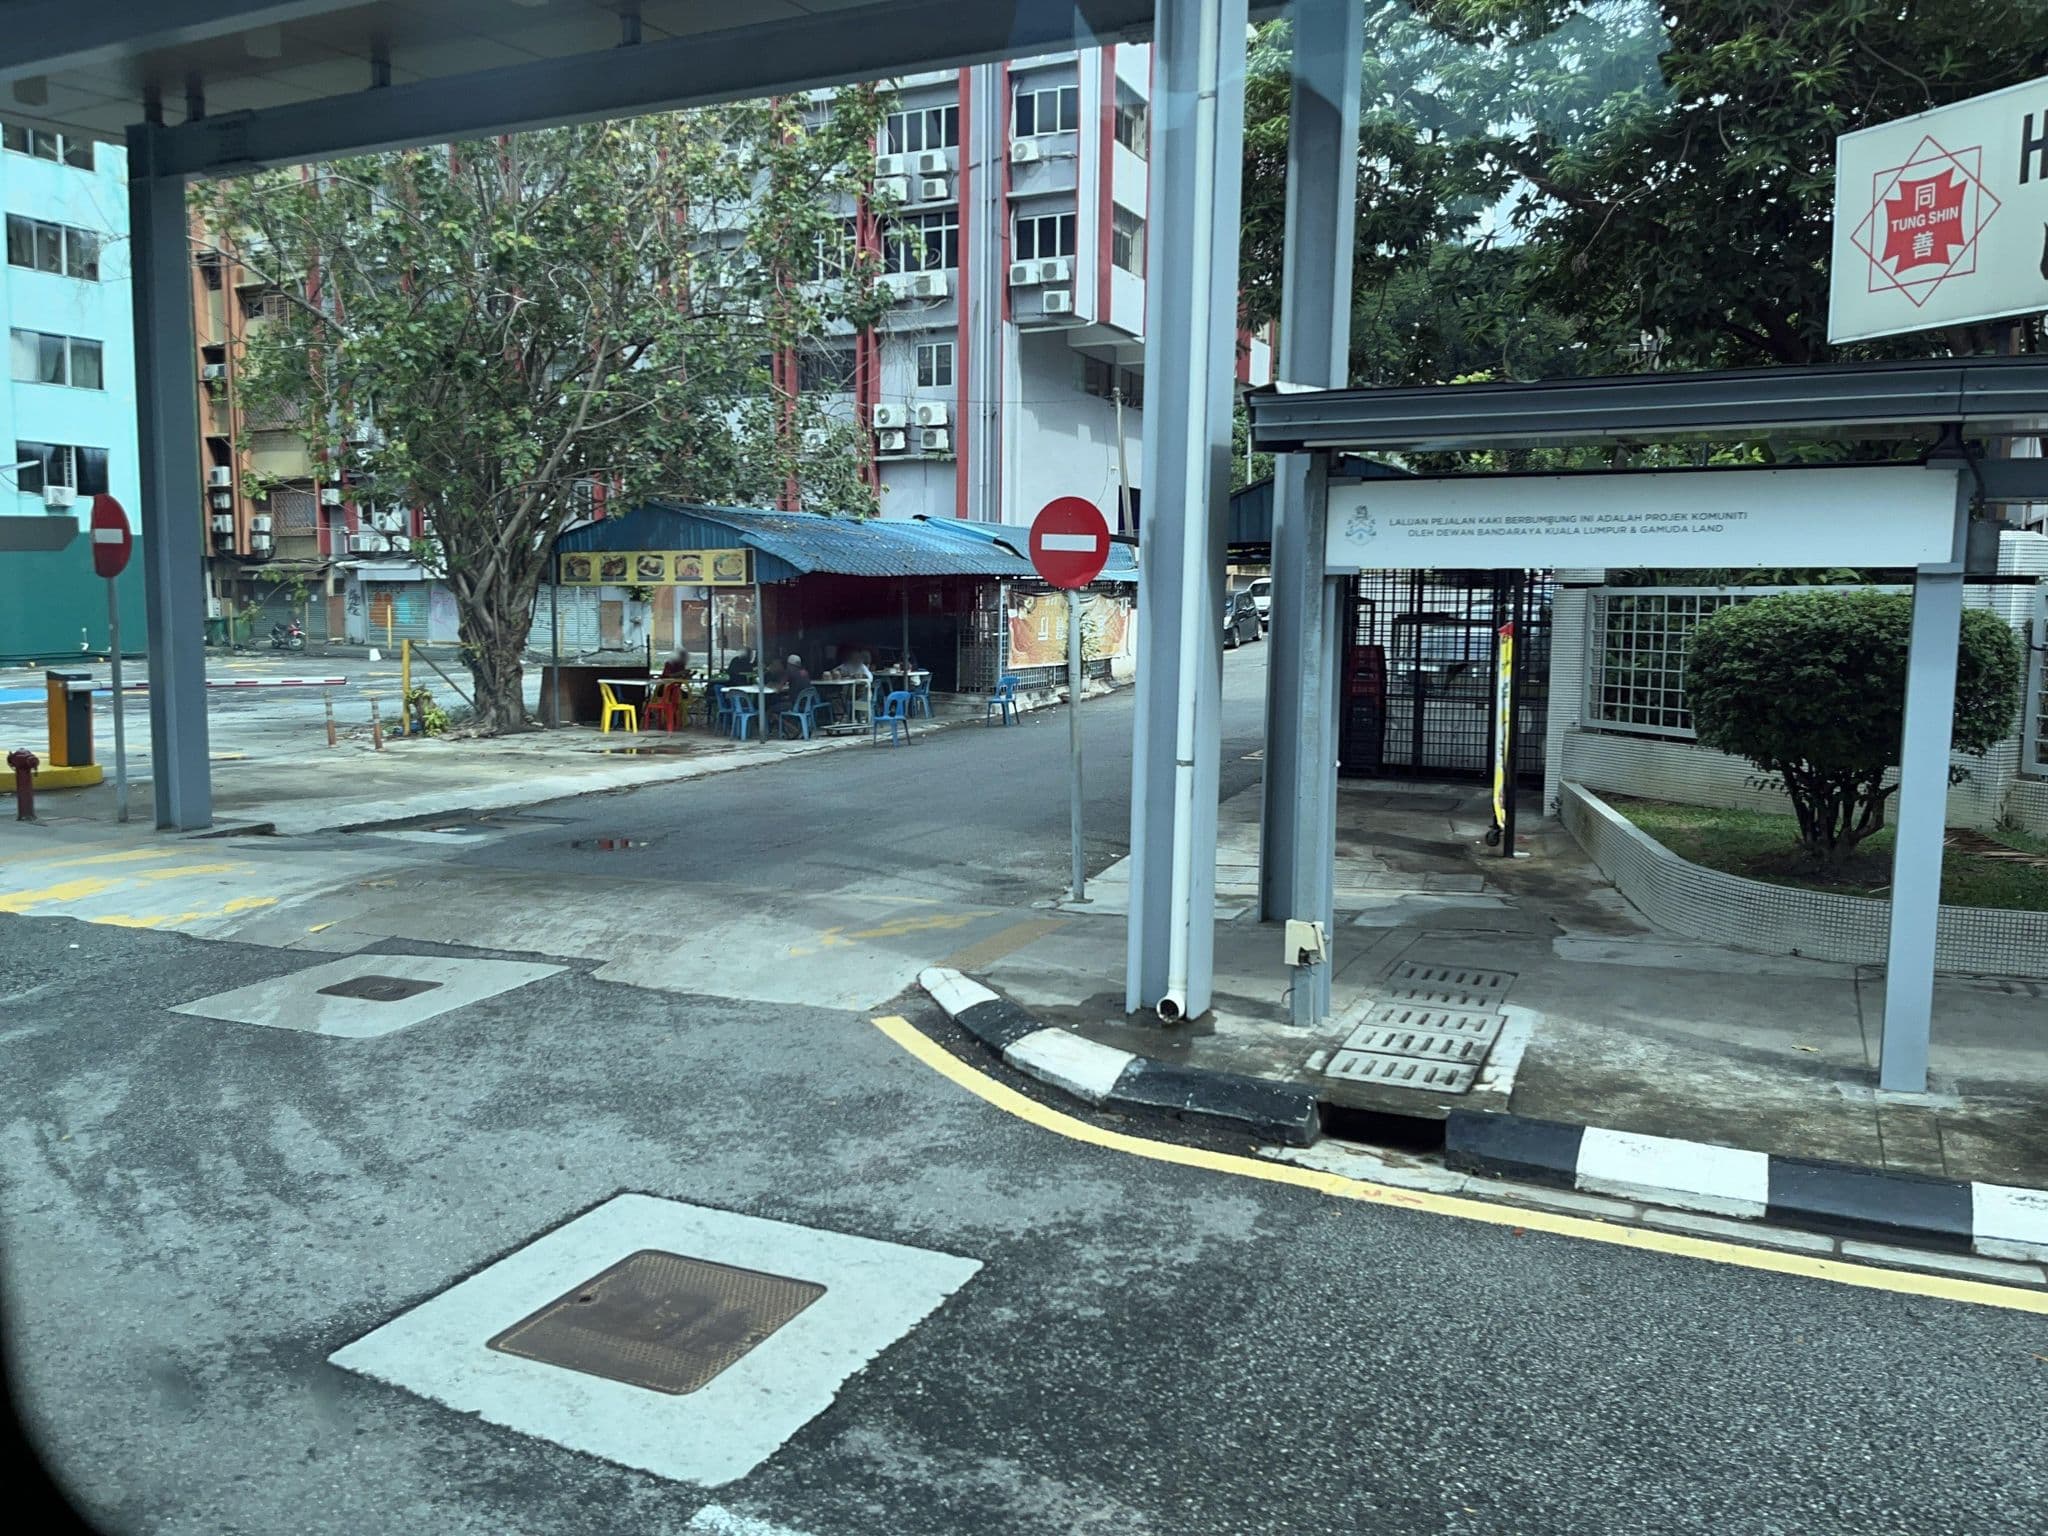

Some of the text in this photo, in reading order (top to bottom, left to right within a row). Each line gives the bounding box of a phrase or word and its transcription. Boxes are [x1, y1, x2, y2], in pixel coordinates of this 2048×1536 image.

[1914, 182, 1937, 211] 同
[1891, 206, 1959, 233] TUNG SHIN
[1912, 231, 1934, 259] 善
[1388, 512, 1748, 526] LALUAN PEJALAN KAKI BERBUMBUNG INI ADALAH PROJEK KOMUNITI
[1408, 524, 1724, 537] OLEH DEWAN BANDARAYA KUALA LUMPUR & GAMUDA LAND
